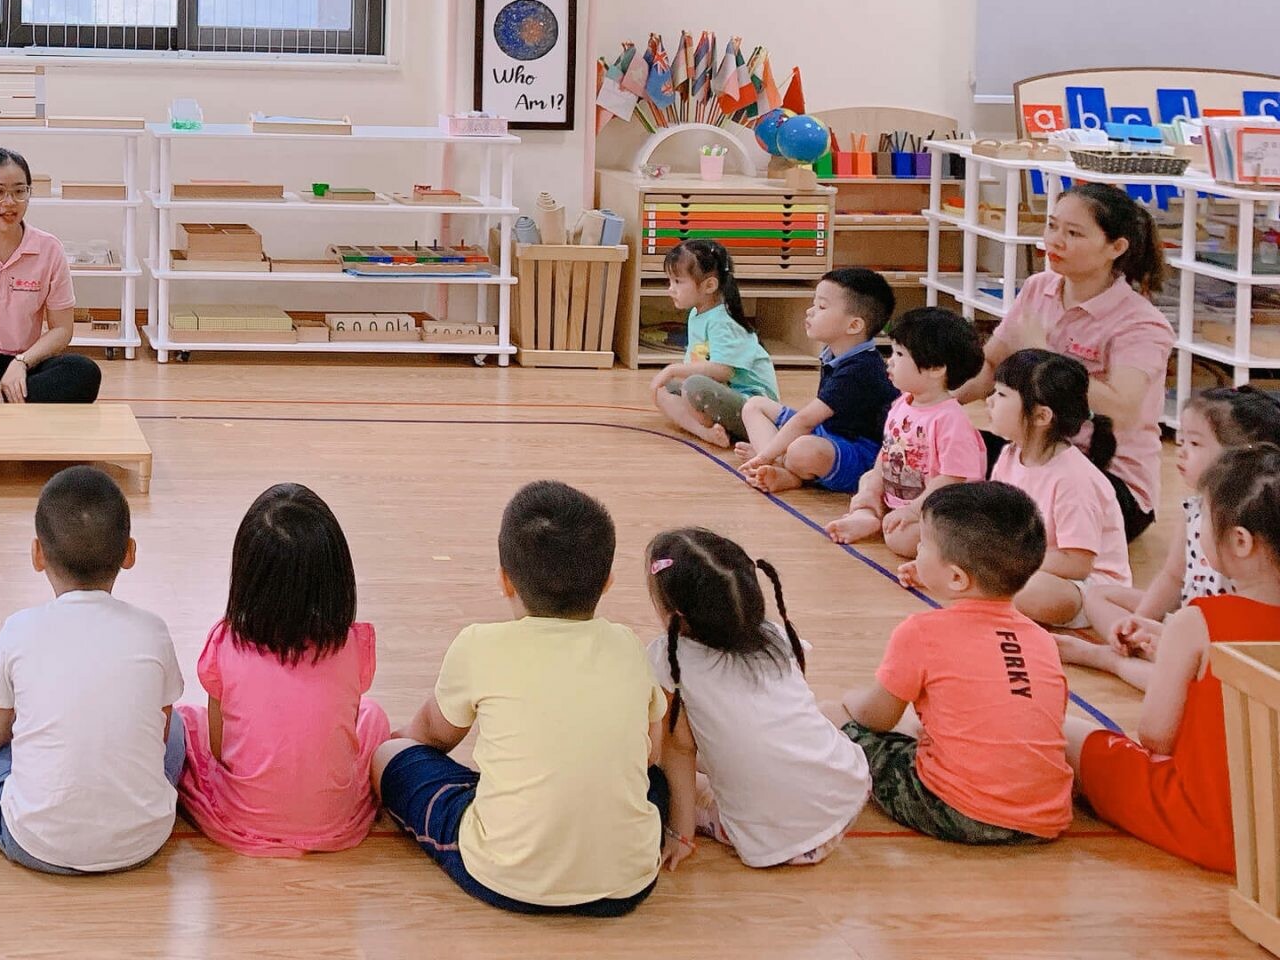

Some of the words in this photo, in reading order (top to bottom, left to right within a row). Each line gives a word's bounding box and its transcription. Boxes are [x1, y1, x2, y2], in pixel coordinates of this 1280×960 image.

[492, 65, 536, 86] Who
[514, 93, 548, 111] Am
[995, 630, 1033, 699] FORKY
